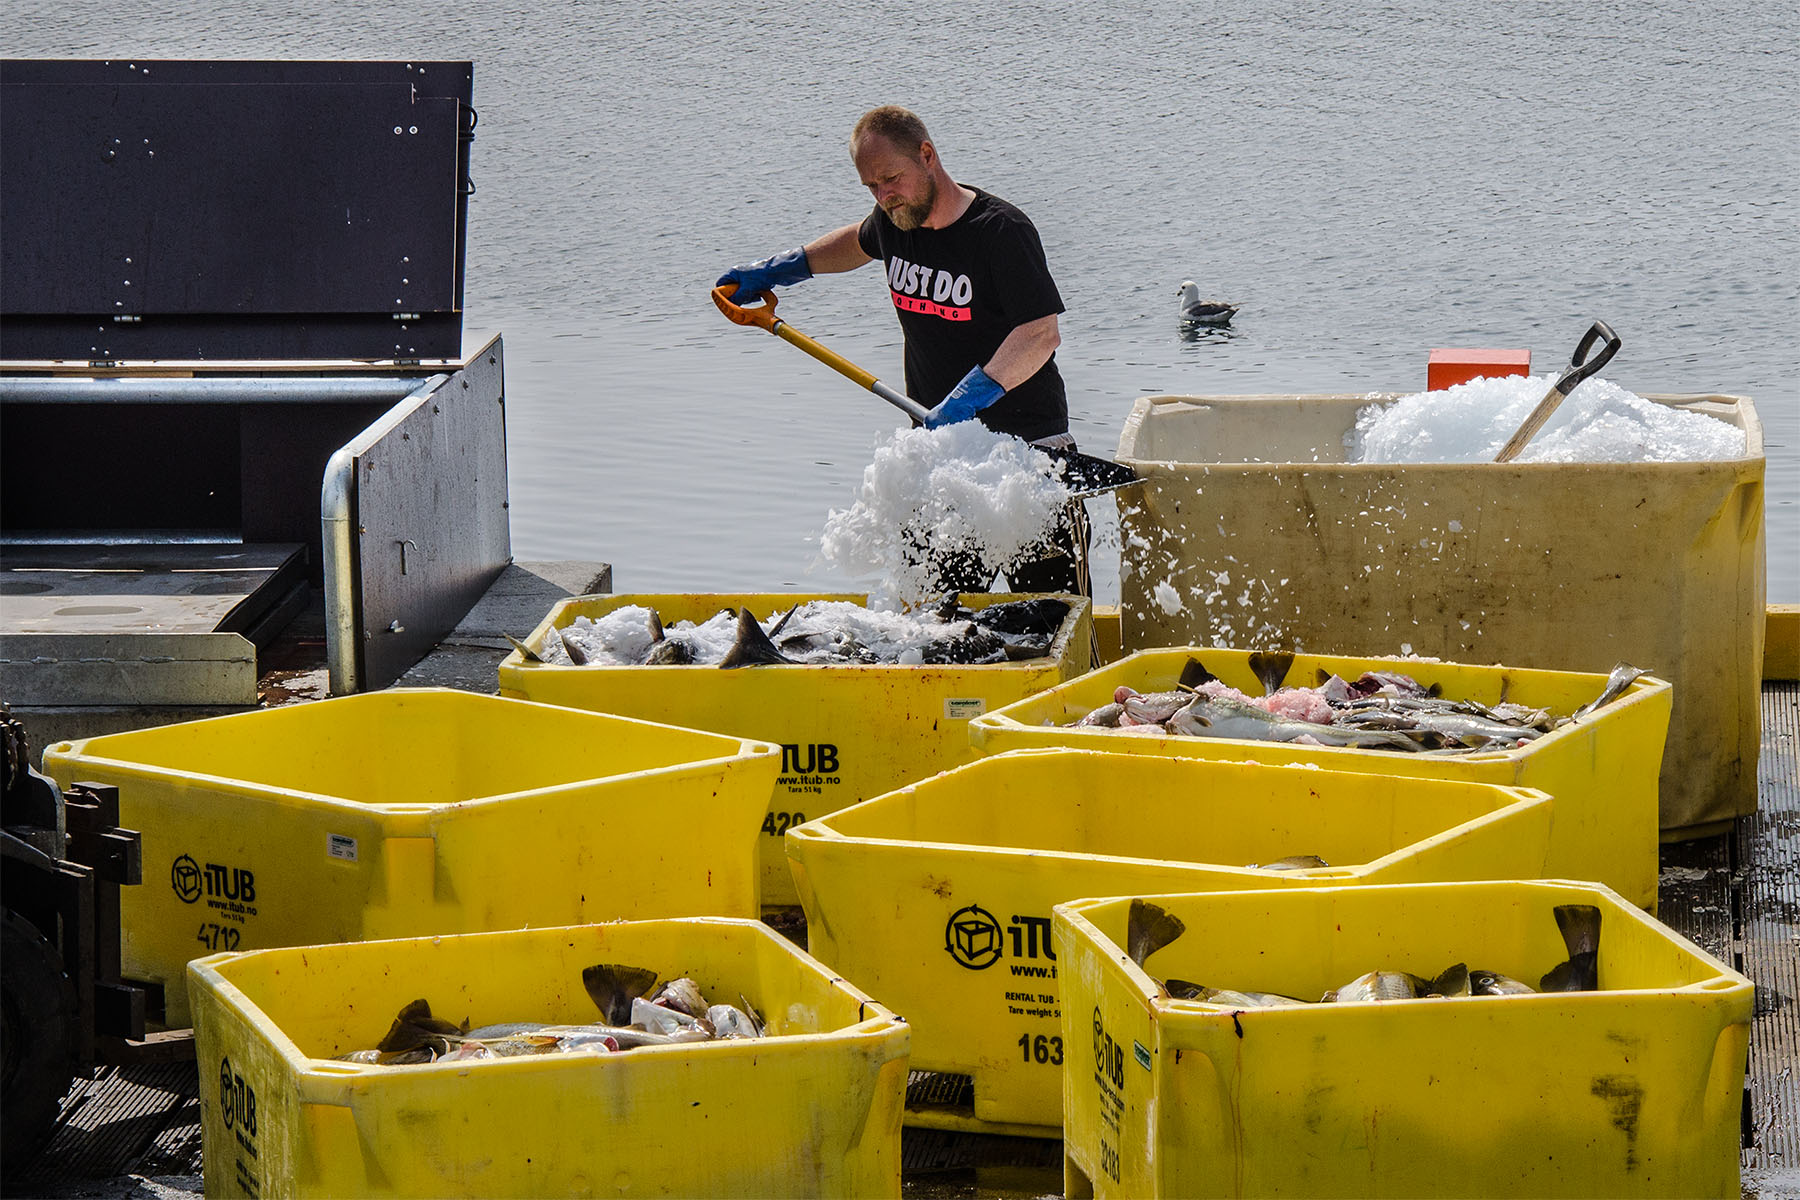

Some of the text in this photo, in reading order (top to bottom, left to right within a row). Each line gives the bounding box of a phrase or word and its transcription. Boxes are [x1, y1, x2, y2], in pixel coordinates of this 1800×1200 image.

[933, 270, 973, 306] DO
[813, 786, 822, 795] kg
[204, 863, 255, 902] iTUB
[207, 899, 257, 916] www.itub.no
[197, 922, 240, 951] 4712
[1010, 965, 1058, 979] www.i
[1005, 991, 1055, 1004] RENTAL TUB
[1008, 1005, 1024, 1015] Tare
[1026, 1007, 1053, 1018] weight
[1018, 1033, 1064, 1066] 163
[234, 1072, 257, 1138] iTUB
